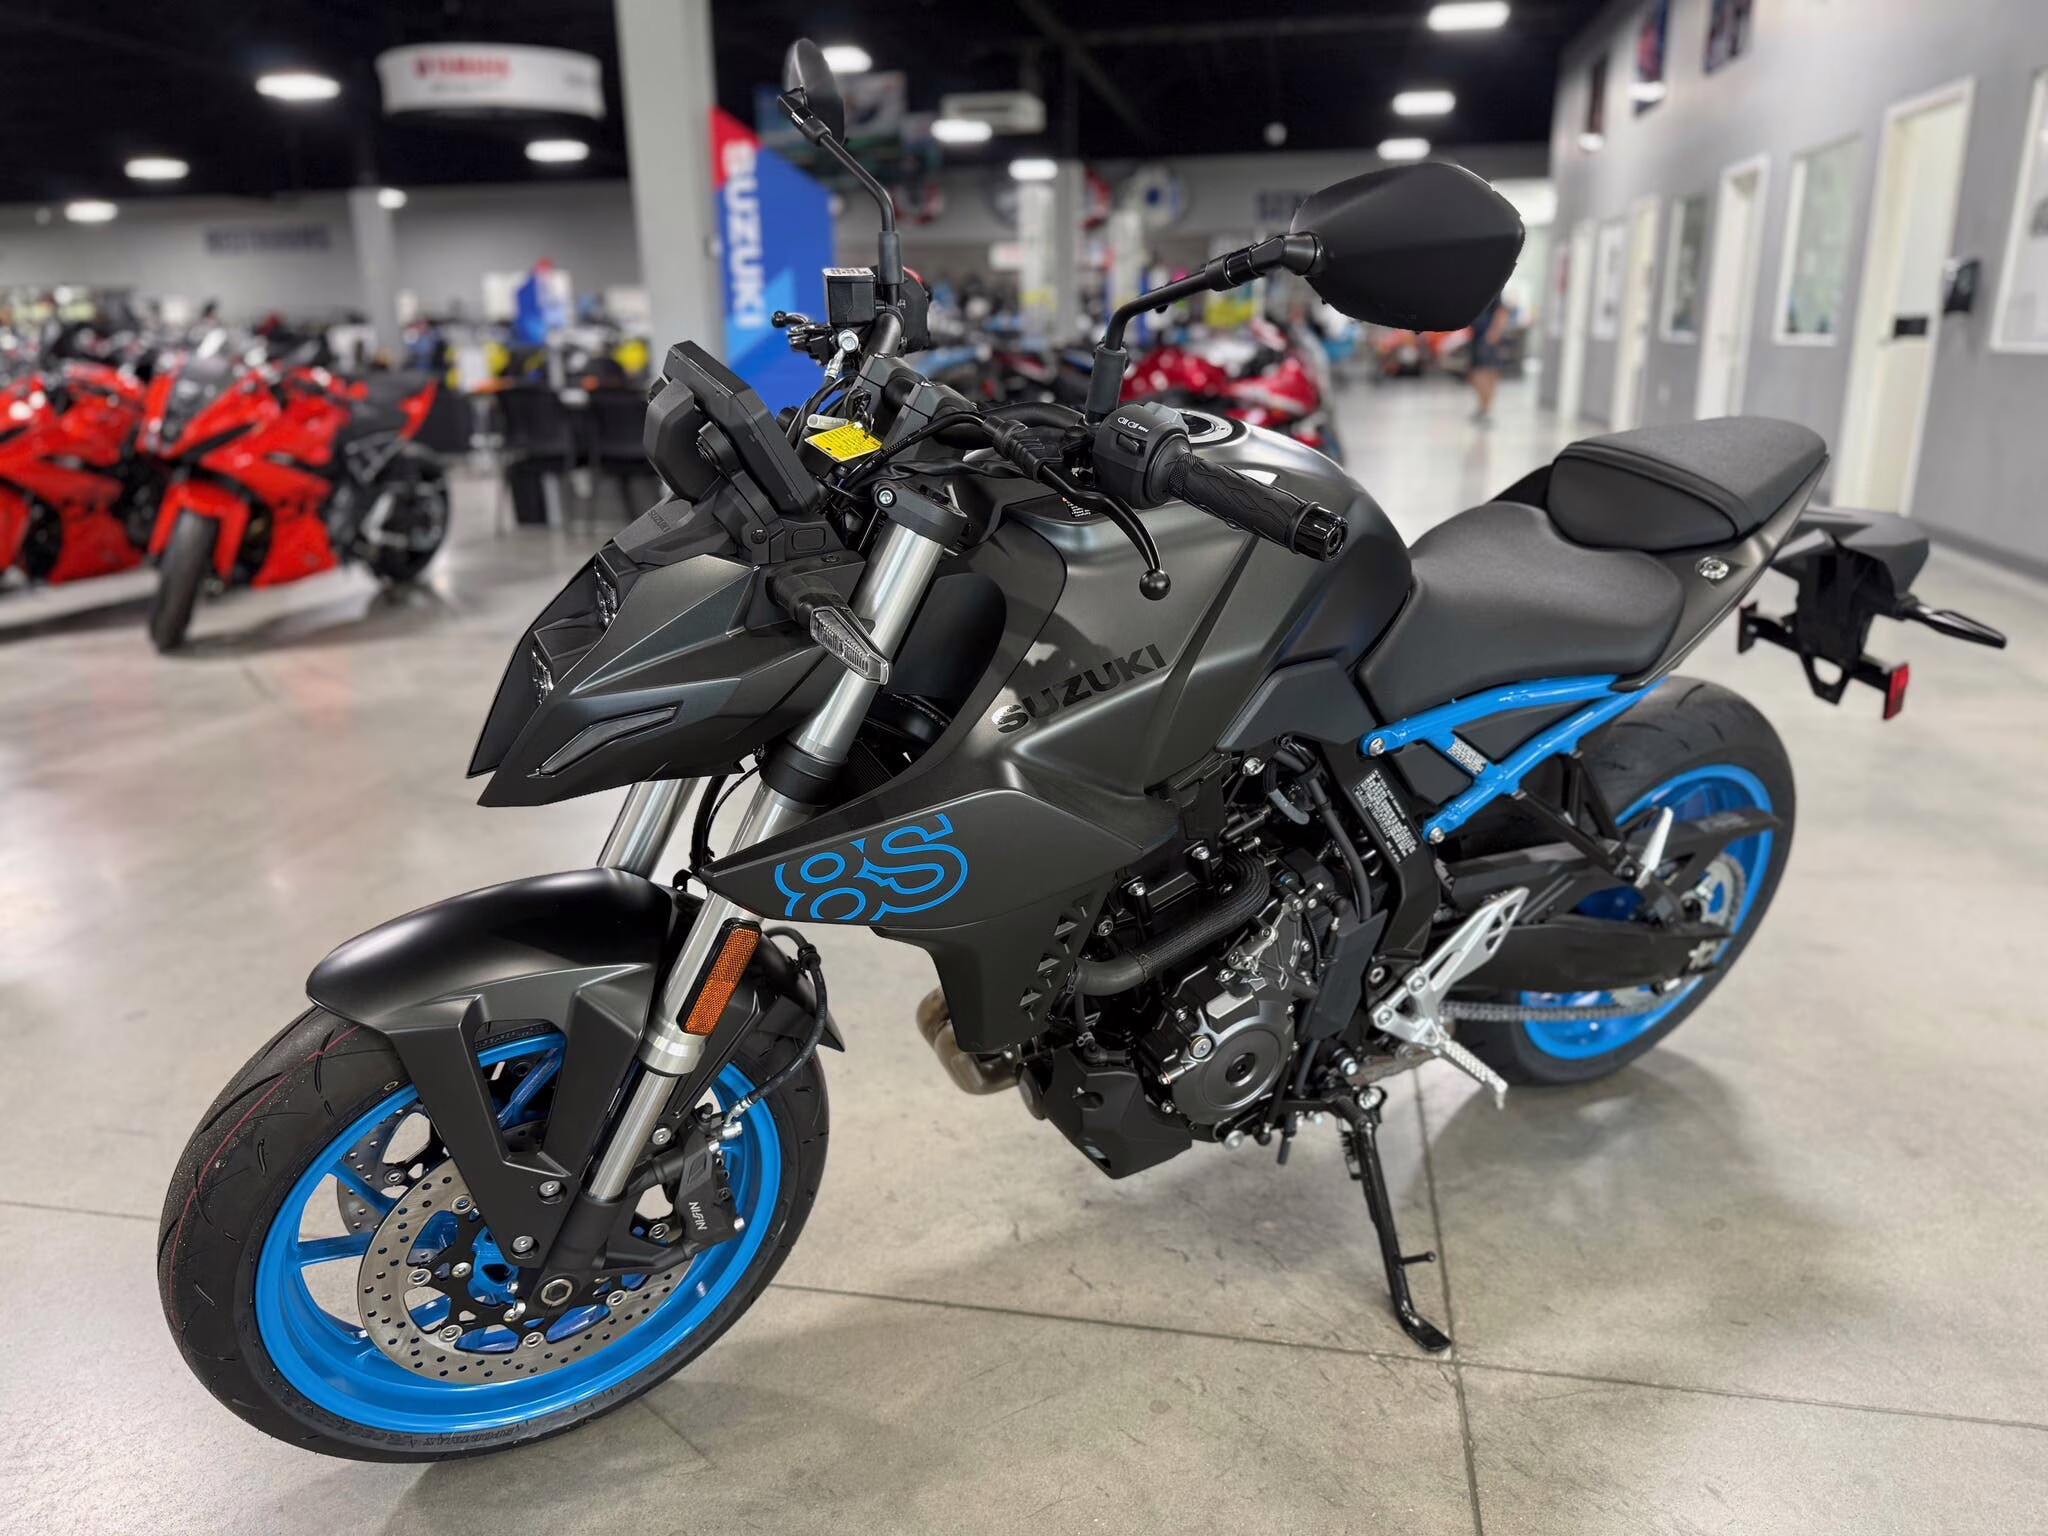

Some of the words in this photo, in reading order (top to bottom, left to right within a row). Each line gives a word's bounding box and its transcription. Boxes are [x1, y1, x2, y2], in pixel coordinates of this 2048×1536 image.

[721, 140, 767, 328] SUZUKI
[647, 509, 672, 532] SUZUKI
[991, 643, 1166, 734] SUZUKI
